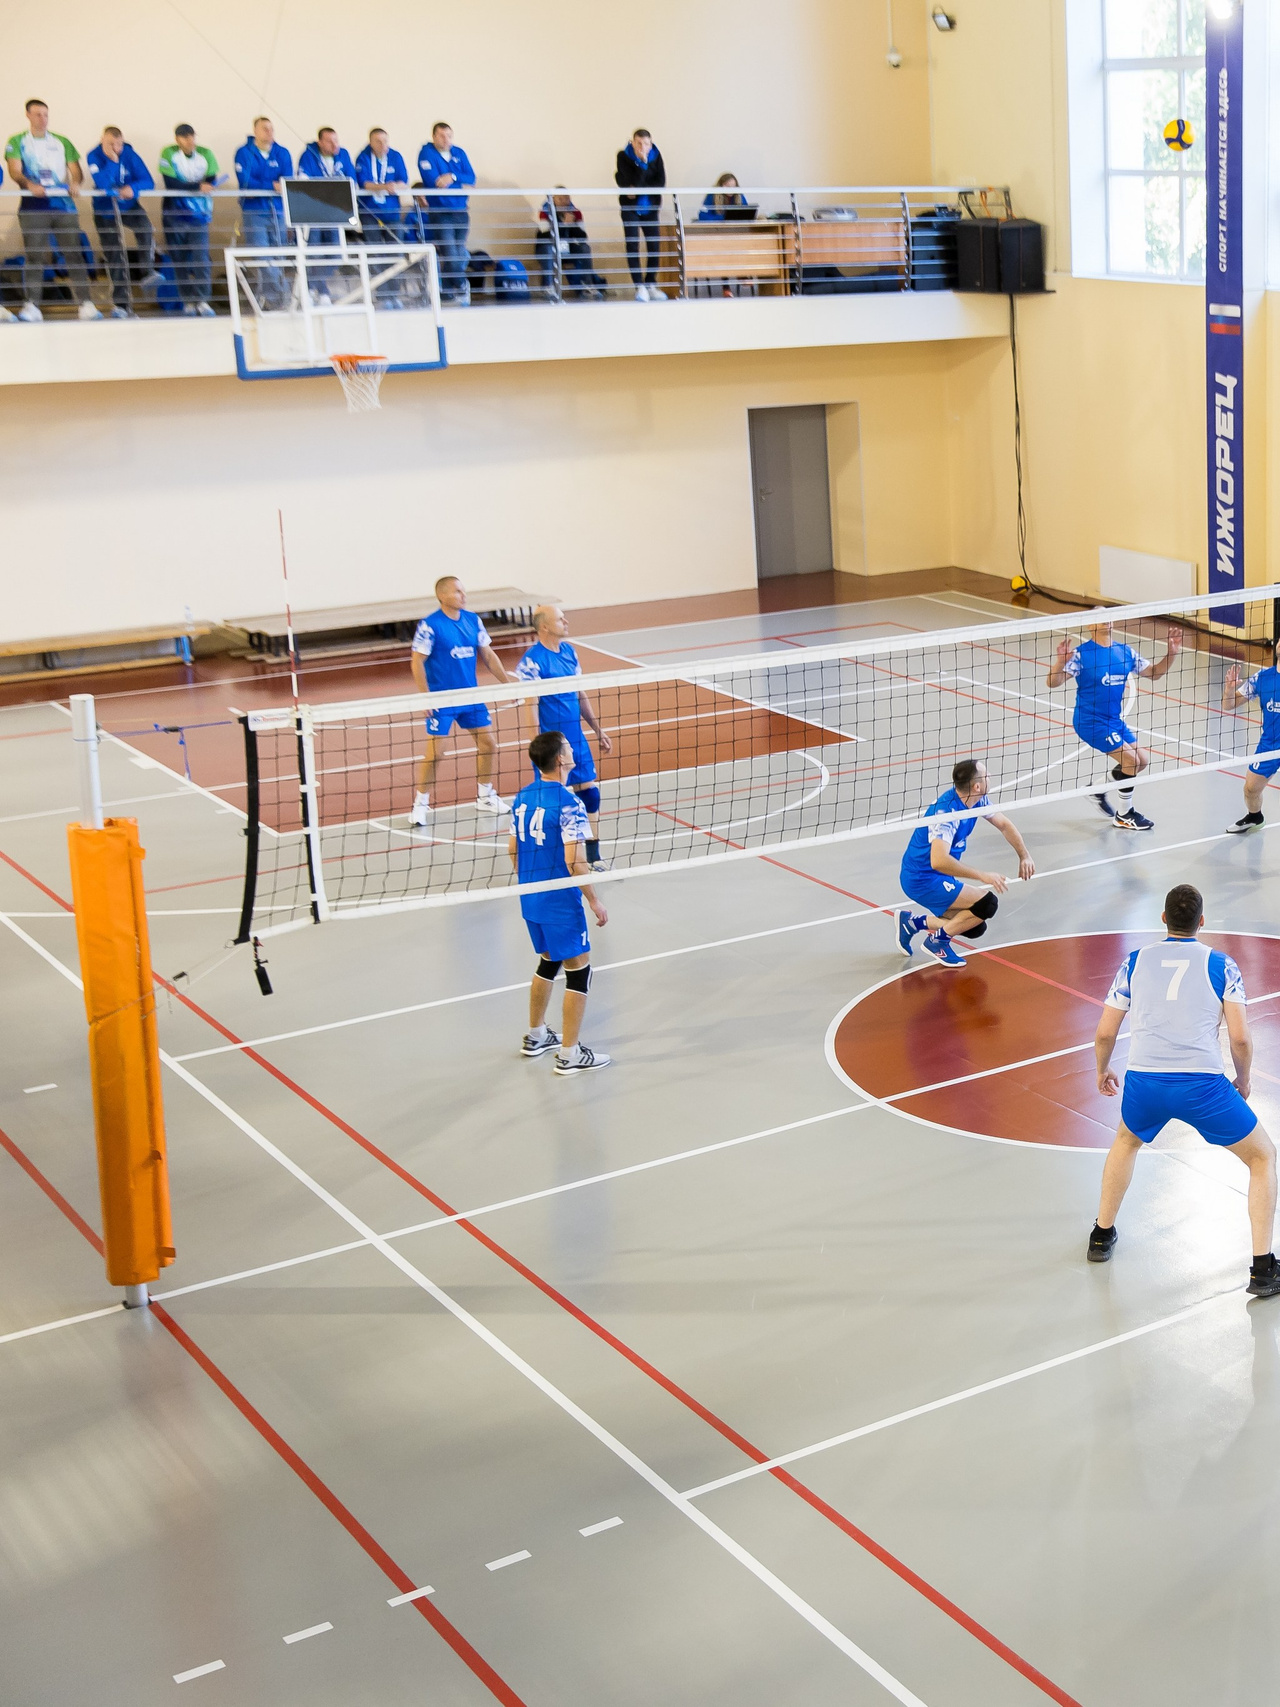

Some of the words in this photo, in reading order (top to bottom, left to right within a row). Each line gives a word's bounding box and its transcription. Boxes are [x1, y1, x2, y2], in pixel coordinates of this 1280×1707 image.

[1218, 67, 1230, 118] ЗДЕСЬ
[1218, 122, 1228, 222] НАЧИНАЕТСЯ
[1218, 223, 1228, 274] СПОРТ
[1216, 371, 1239, 577] ИЖОРЕЦ
[1106, 731, 1122, 746] 16
[515, 803, 546, 846] 14
[942, 880, 956, 892] 4
[581, 930, 590, 946] 1
[1161, 960, 1190, 1000] 7
